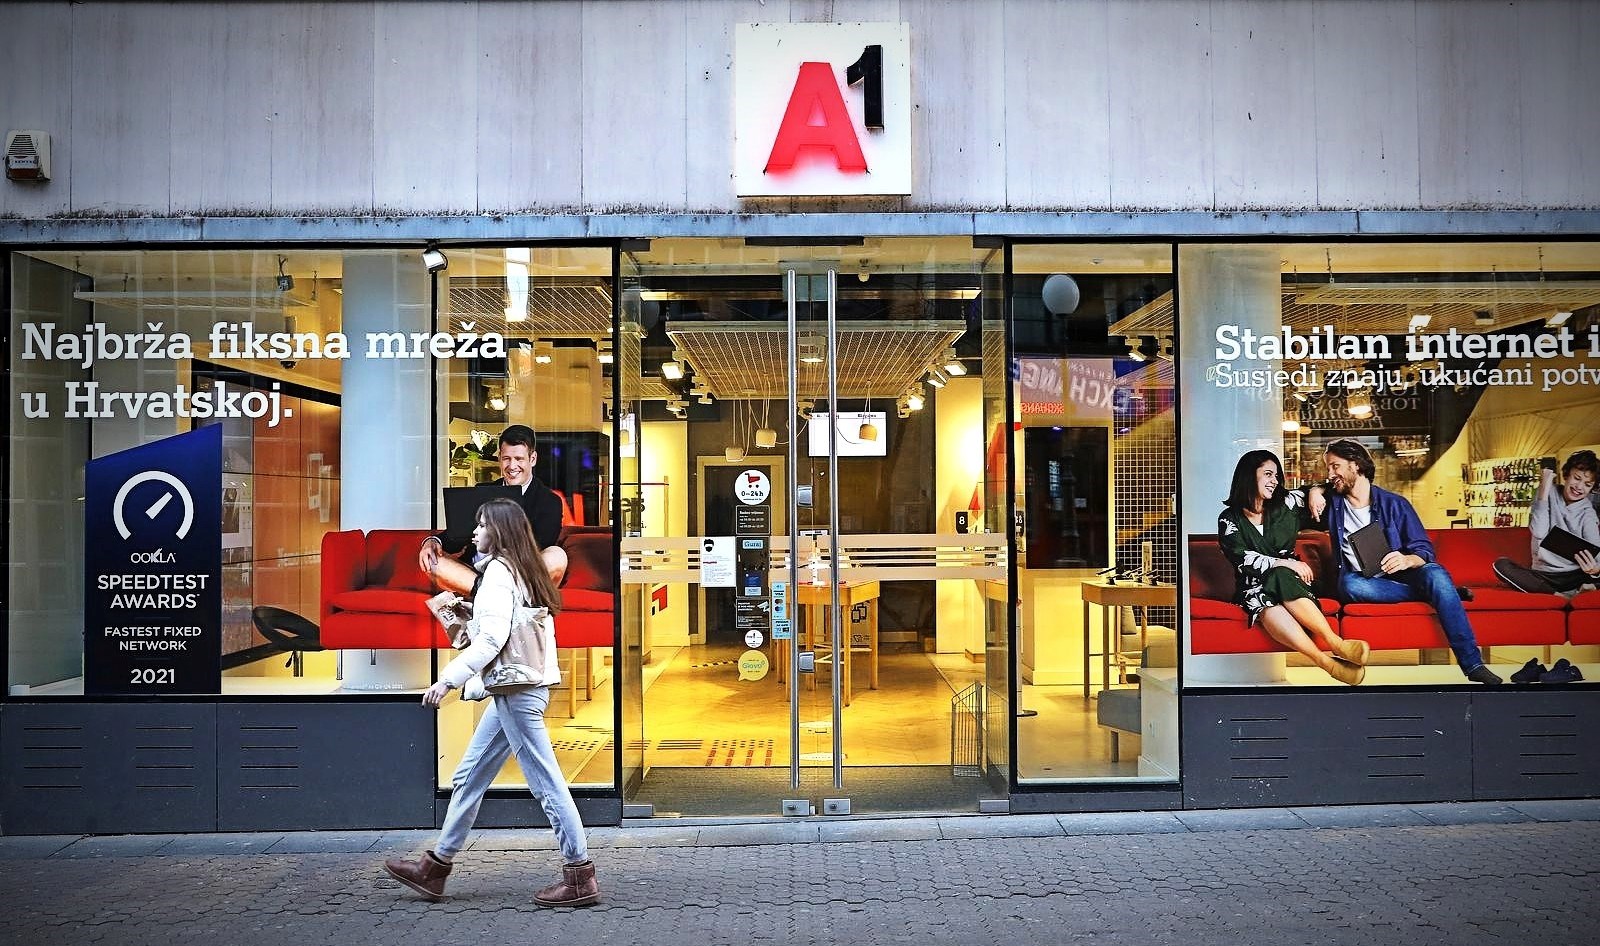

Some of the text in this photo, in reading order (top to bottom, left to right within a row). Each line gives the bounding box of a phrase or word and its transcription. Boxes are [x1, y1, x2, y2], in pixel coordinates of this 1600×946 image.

[763, 44, 884, 172] A1
[21, 321, 507, 369] Najbrža fiksna mreža
[1215, 324, 1392, 360] Stabilan
[1405, 325, 1575, 359] internet
[1216, 362, 1318, 393] Susjedi
[1327, 363, 1409, 393] znaju,
[1420, 361, 1534, 386] ukućani
[20, 380, 294, 428] u Hrvatskoj.
[130, 548, 177, 564] OOKLA
[97, 574, 210, 590] SPEEDTEST
[104, 626, 202, 637] FASTEST FIXED
[119, 640, 187, 651] NETWORK
[130, 668, 175, 684] 2021
